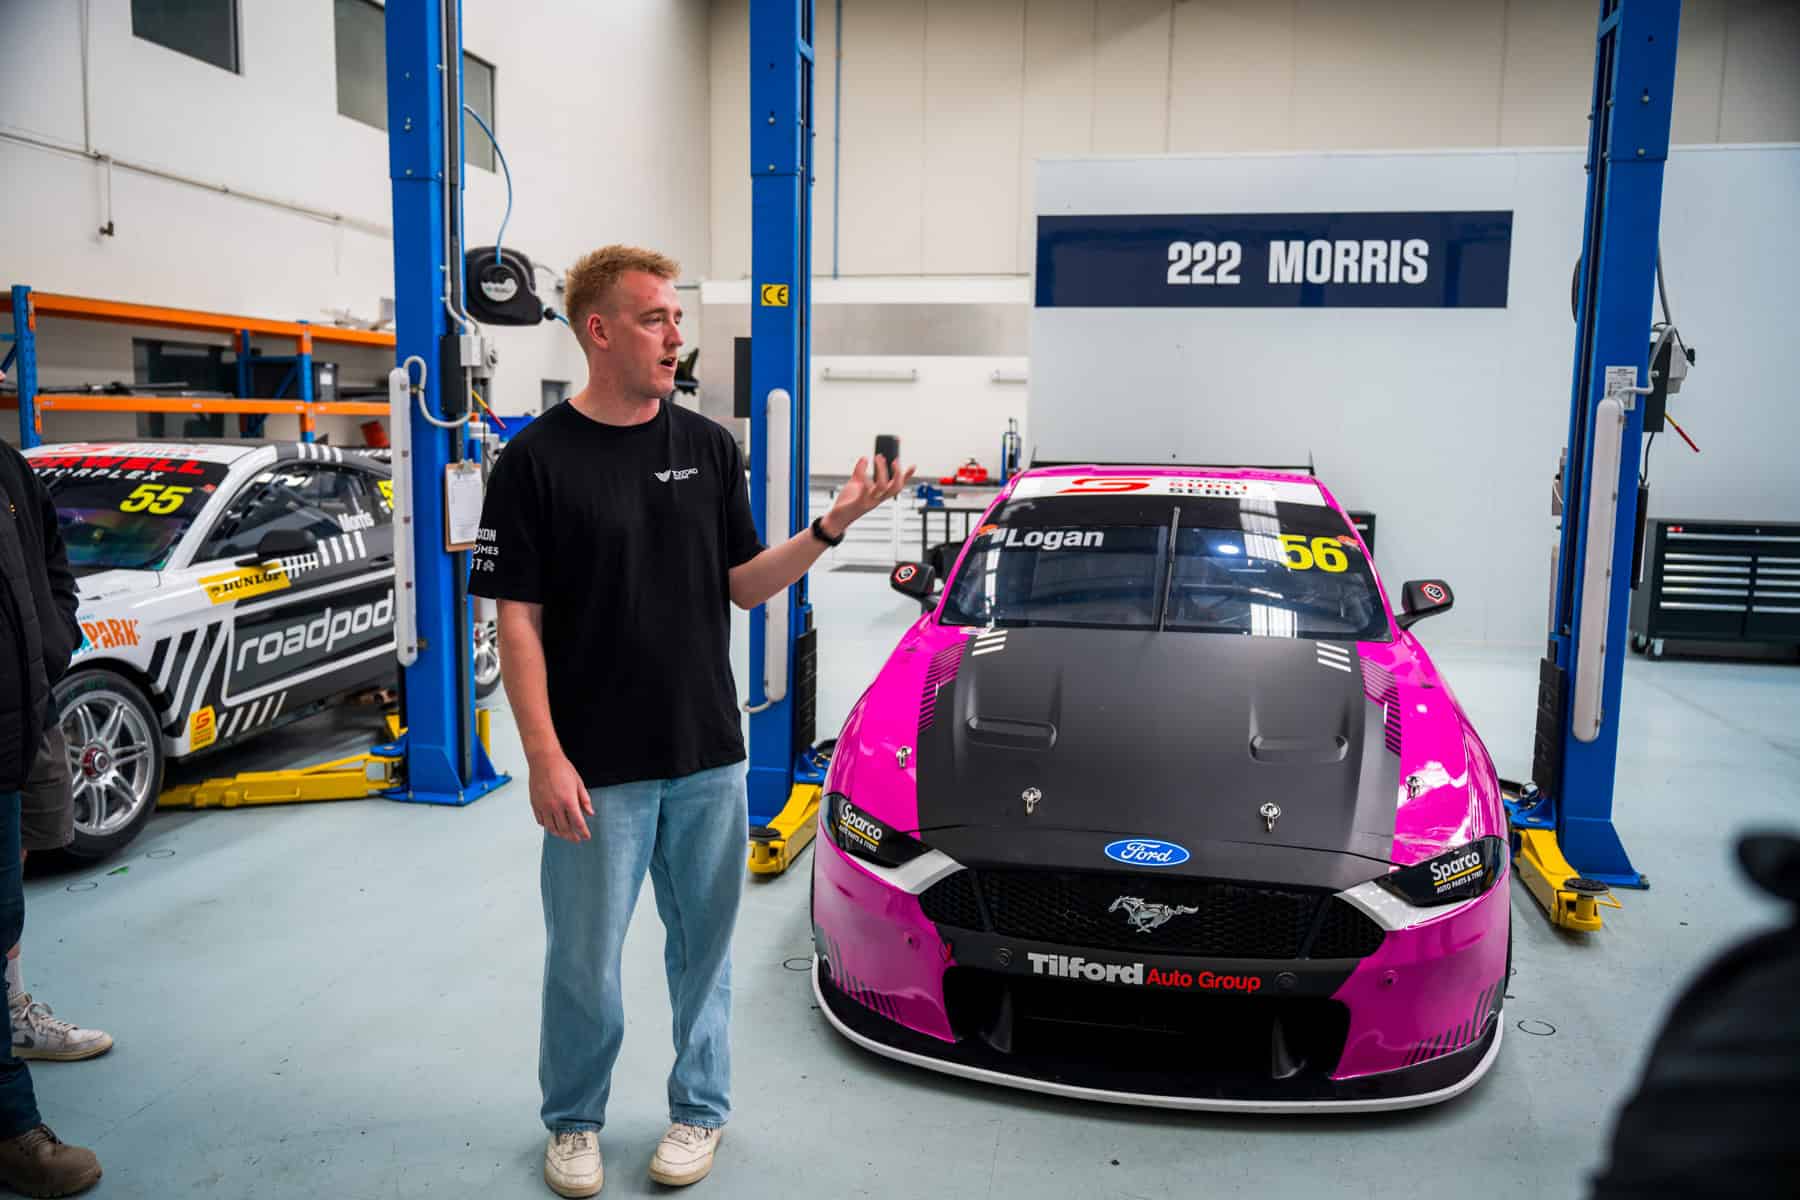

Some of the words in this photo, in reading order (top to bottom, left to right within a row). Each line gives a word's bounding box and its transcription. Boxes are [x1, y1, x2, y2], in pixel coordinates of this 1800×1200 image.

[1167, 240, 1242, 285] 222
[1268, 238, 1430, 285] MORRIS
[26, 456, 206, 476] ORWELL
[119, 483, 193, 515] 55
[1005, 528, 1105, 551] Logan
[1278, 533, 1349, 573] 56
[842, 804, 882, 840] Sparco
[1120, 841, 1174, 863] Ford
[1430, 852, 1480, 882] Sparco
[1027, 952, 1145, 986] Tilford
[1145, 968, 1193, 988] Auto
[1197, 970, 1262, 993] Group
